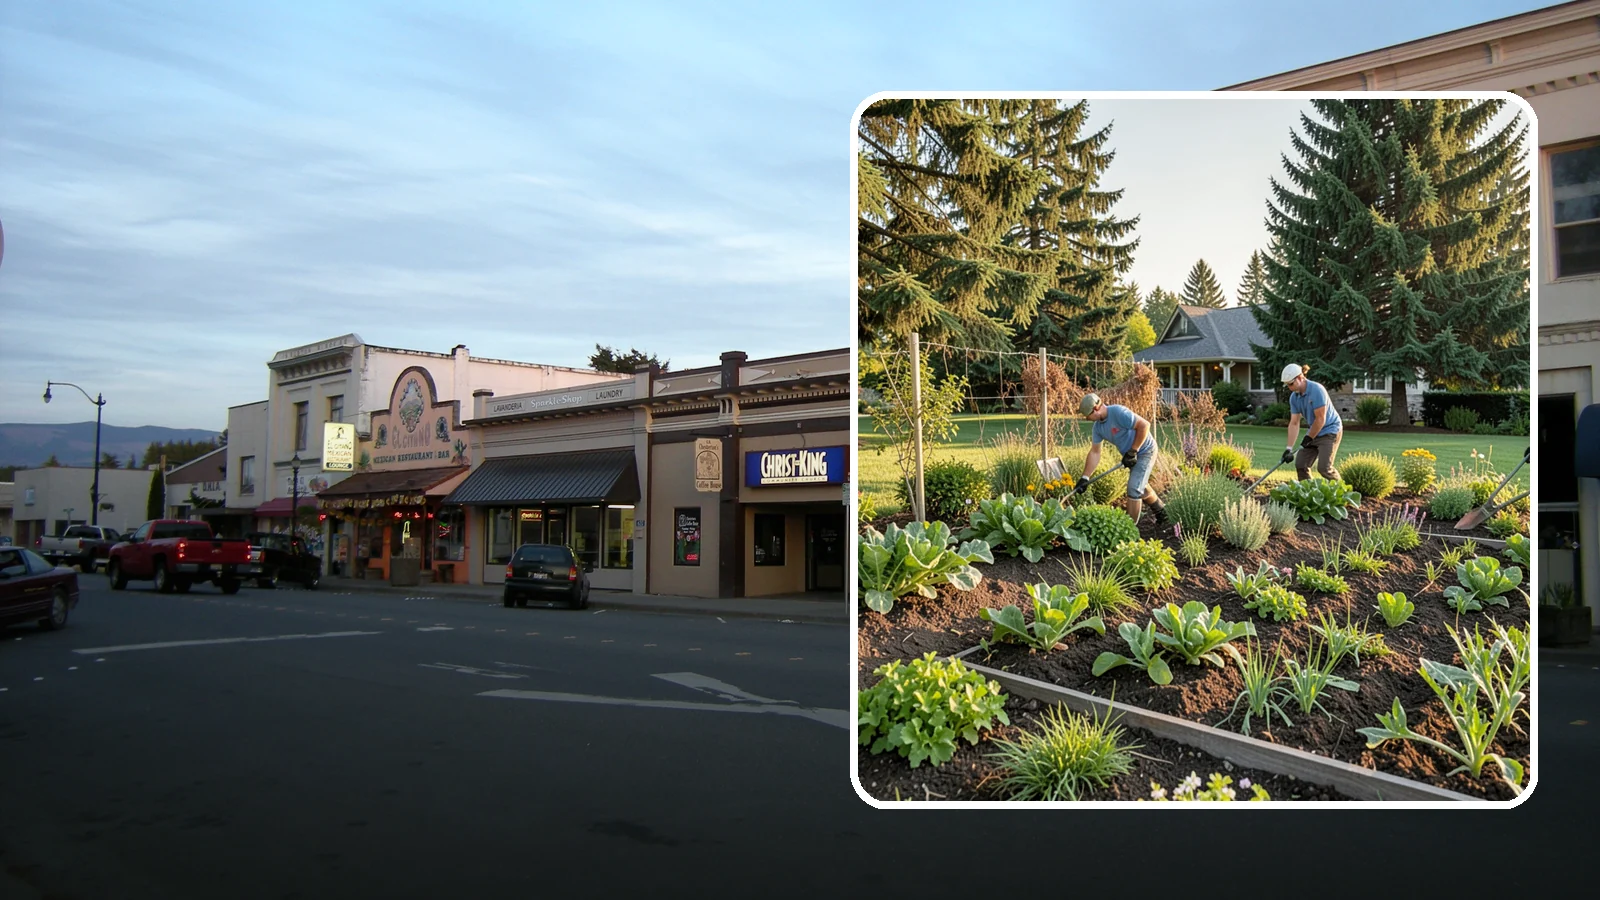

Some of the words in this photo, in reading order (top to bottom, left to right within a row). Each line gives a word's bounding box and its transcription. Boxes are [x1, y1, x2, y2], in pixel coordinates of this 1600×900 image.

[561, 394, 582, 405] Shop
[595, 388, 624, 400] LAUNDRY
[493, 402, 522, 412] LAVANDERIA
[373, 454, 396, 464] MEXICAN
[397, 451, 434, 462] RESTAURANT
[437, 450, 450, 459] BAR
[760, 452, 797, 478] CHRIST
[799, 450, 828, 476] KING
[710, 481, 722, 489] House
